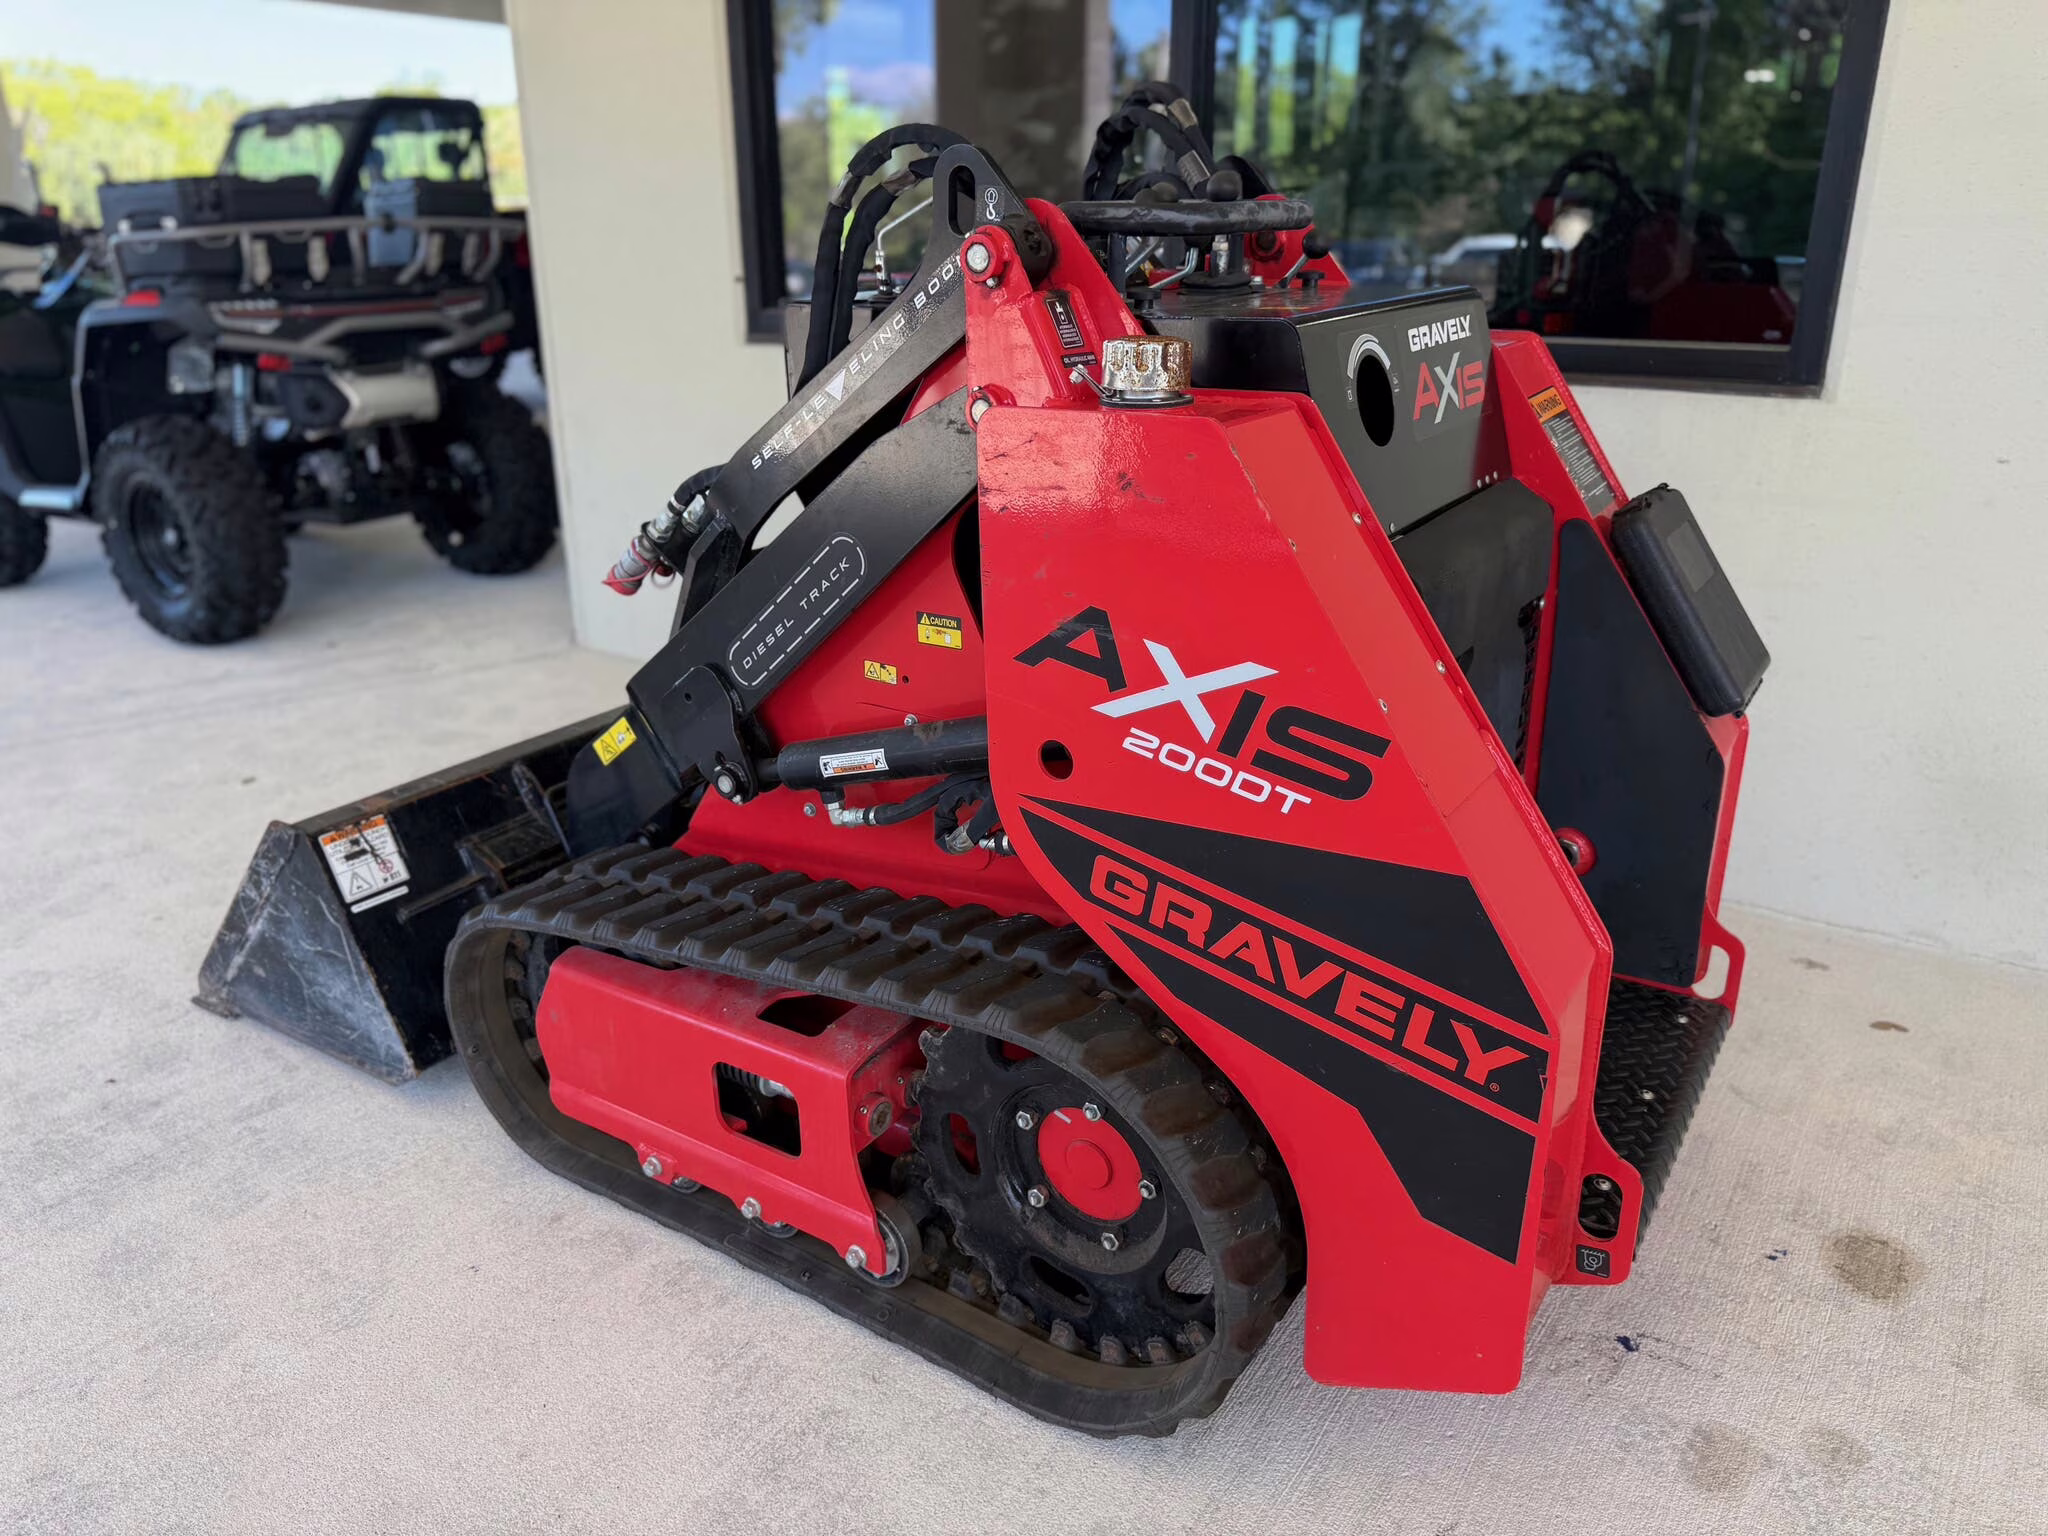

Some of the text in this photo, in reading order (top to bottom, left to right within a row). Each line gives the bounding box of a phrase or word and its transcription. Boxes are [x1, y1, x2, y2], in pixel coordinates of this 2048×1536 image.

[1407, 314, 1472, 352] GRAVELY
[1413, 352, 1485, 424] AXIS
[1537, 393, 1562, 414] WARNING
[742, 556, 850, 669] DIESEL TRACK
[930, 616, 957, 628] CAUTION
[1012, 605, 1392, 800] AXIS
[1122, 727, 1312, 814] 200DT
